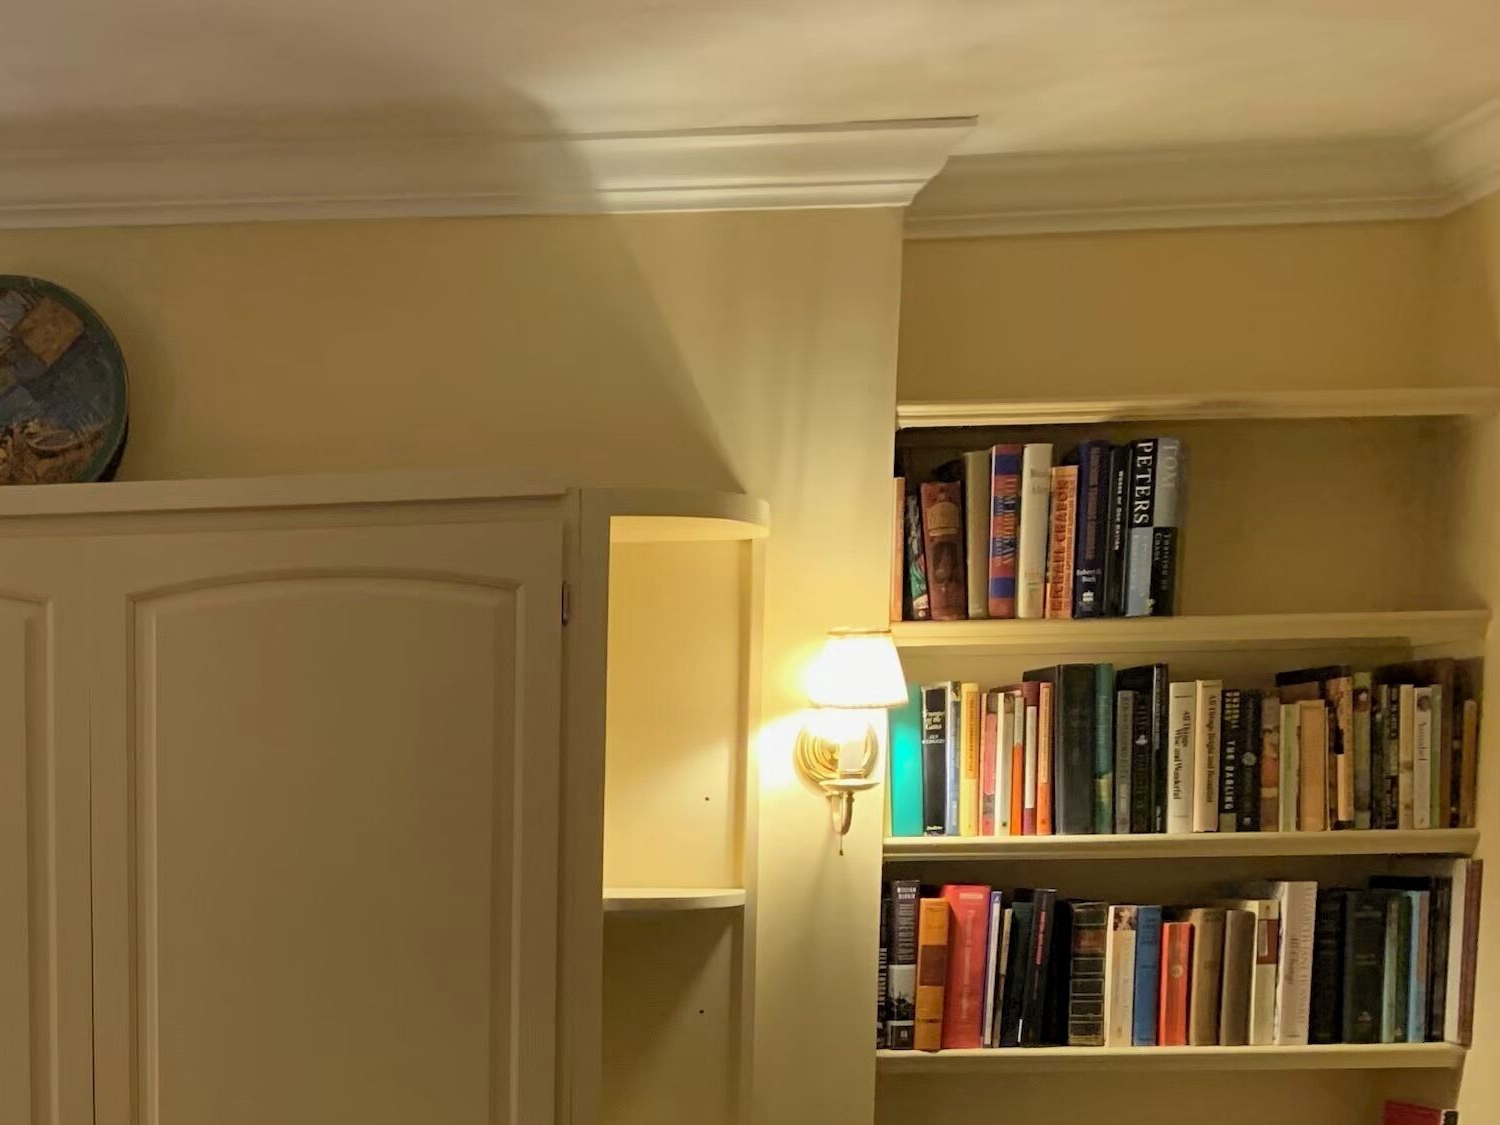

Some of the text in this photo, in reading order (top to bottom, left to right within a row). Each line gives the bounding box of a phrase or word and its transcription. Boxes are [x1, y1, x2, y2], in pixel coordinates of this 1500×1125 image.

[1133, 441, 1154, 525] PETERS
[1161, 445, 1178, 489] TOM
[1181, 723, 1189, 747] Things
[1206, 708, 1215, 731] Things
[1206, 733, 1215, 754] Bright
[1417, 721, 1427, 763] Annabel
[1173, 763, 1182, 800] Wonderful
[1206, 770, 1215, 803] Beautiful
[1224, 740, 1235, 810] THE DARLING
[1299, 947, 1311, 973] JANE
[1297, 976, 1308, 1024] HOWARD
